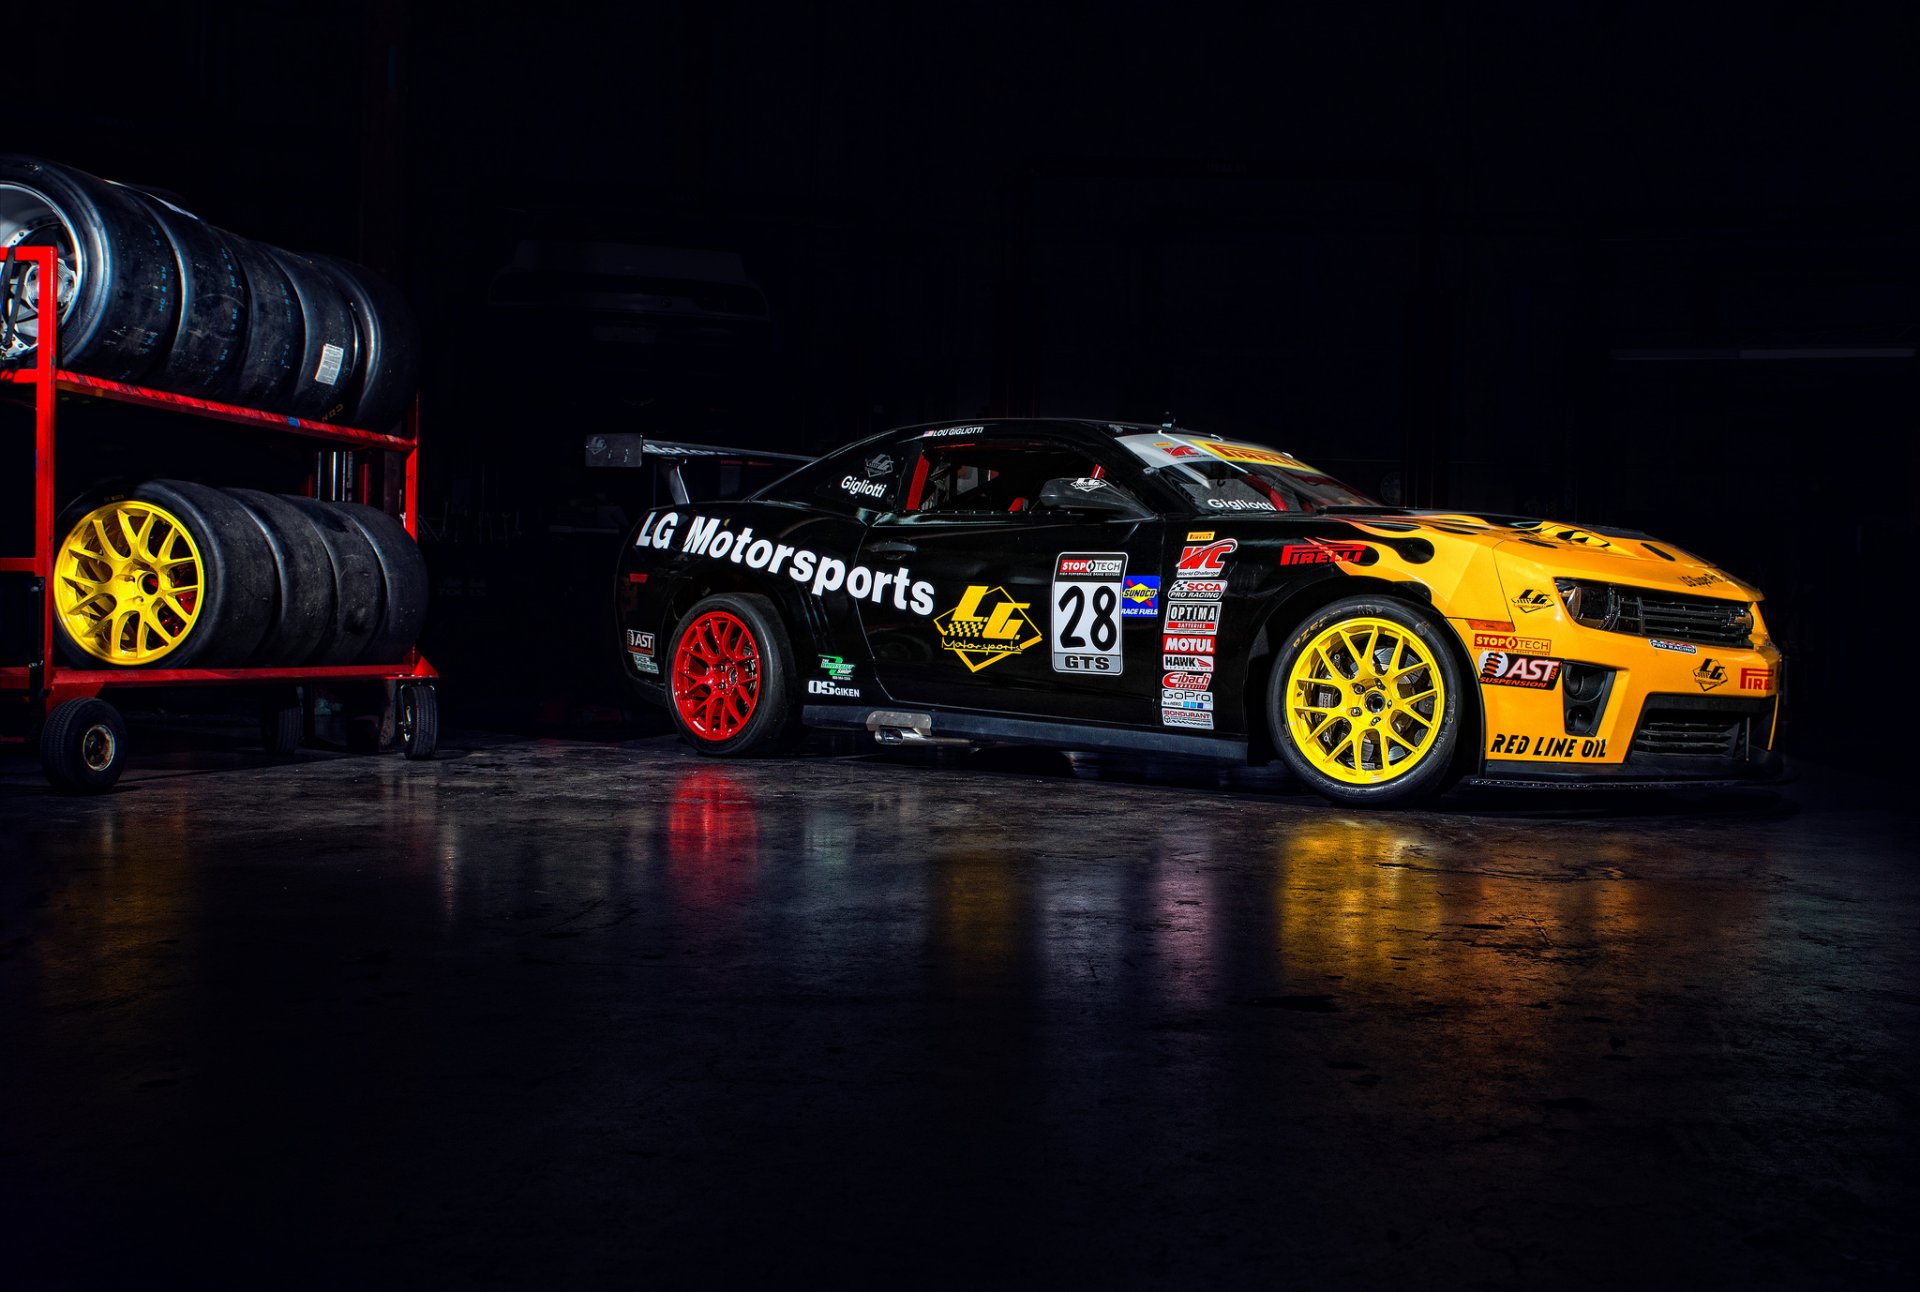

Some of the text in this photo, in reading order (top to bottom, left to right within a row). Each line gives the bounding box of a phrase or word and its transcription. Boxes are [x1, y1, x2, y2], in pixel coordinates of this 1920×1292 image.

[949, 427, 984, 436] GIGLIOTTI
[841, 475, 887, 498] Gigliotti
[1207, 498, 1277, 512] Gigliotti
[1280, 544, 1367, 566] PIRELLI
[635, 511, 935, 616] LG Motorsports
[1124, 589, 1157, 597] SUNOCO
[1187, 583, 1222, 591] SCCA
[1058, 585, 1117, 651] 28
[1170, 606, 1215, 621] OPTIMA
[635, 634, 653, 648] AST
[942, 637, 1023, 656] Motorsports
[1165, 637, 1213, 652] MOTUL
[1668, 645, 1696, 653] RACING
[1064, 655, 1110, 670] GTS
[1165, 656, 1197, 667] HAWK
[1505, 658, 1560, 681] AST USA
[1162, 673, 1211, 688] Eibach
[1479, 676, 1548, 688] SUSPENSION
[808, 680, 860, 698] OS GIKEN
[1162, 689, 1211, 702] GoPro
[1164, 710, 1211, 718] BONDURANT
[1490, 733, 1607, 758] RED LINE OIL
